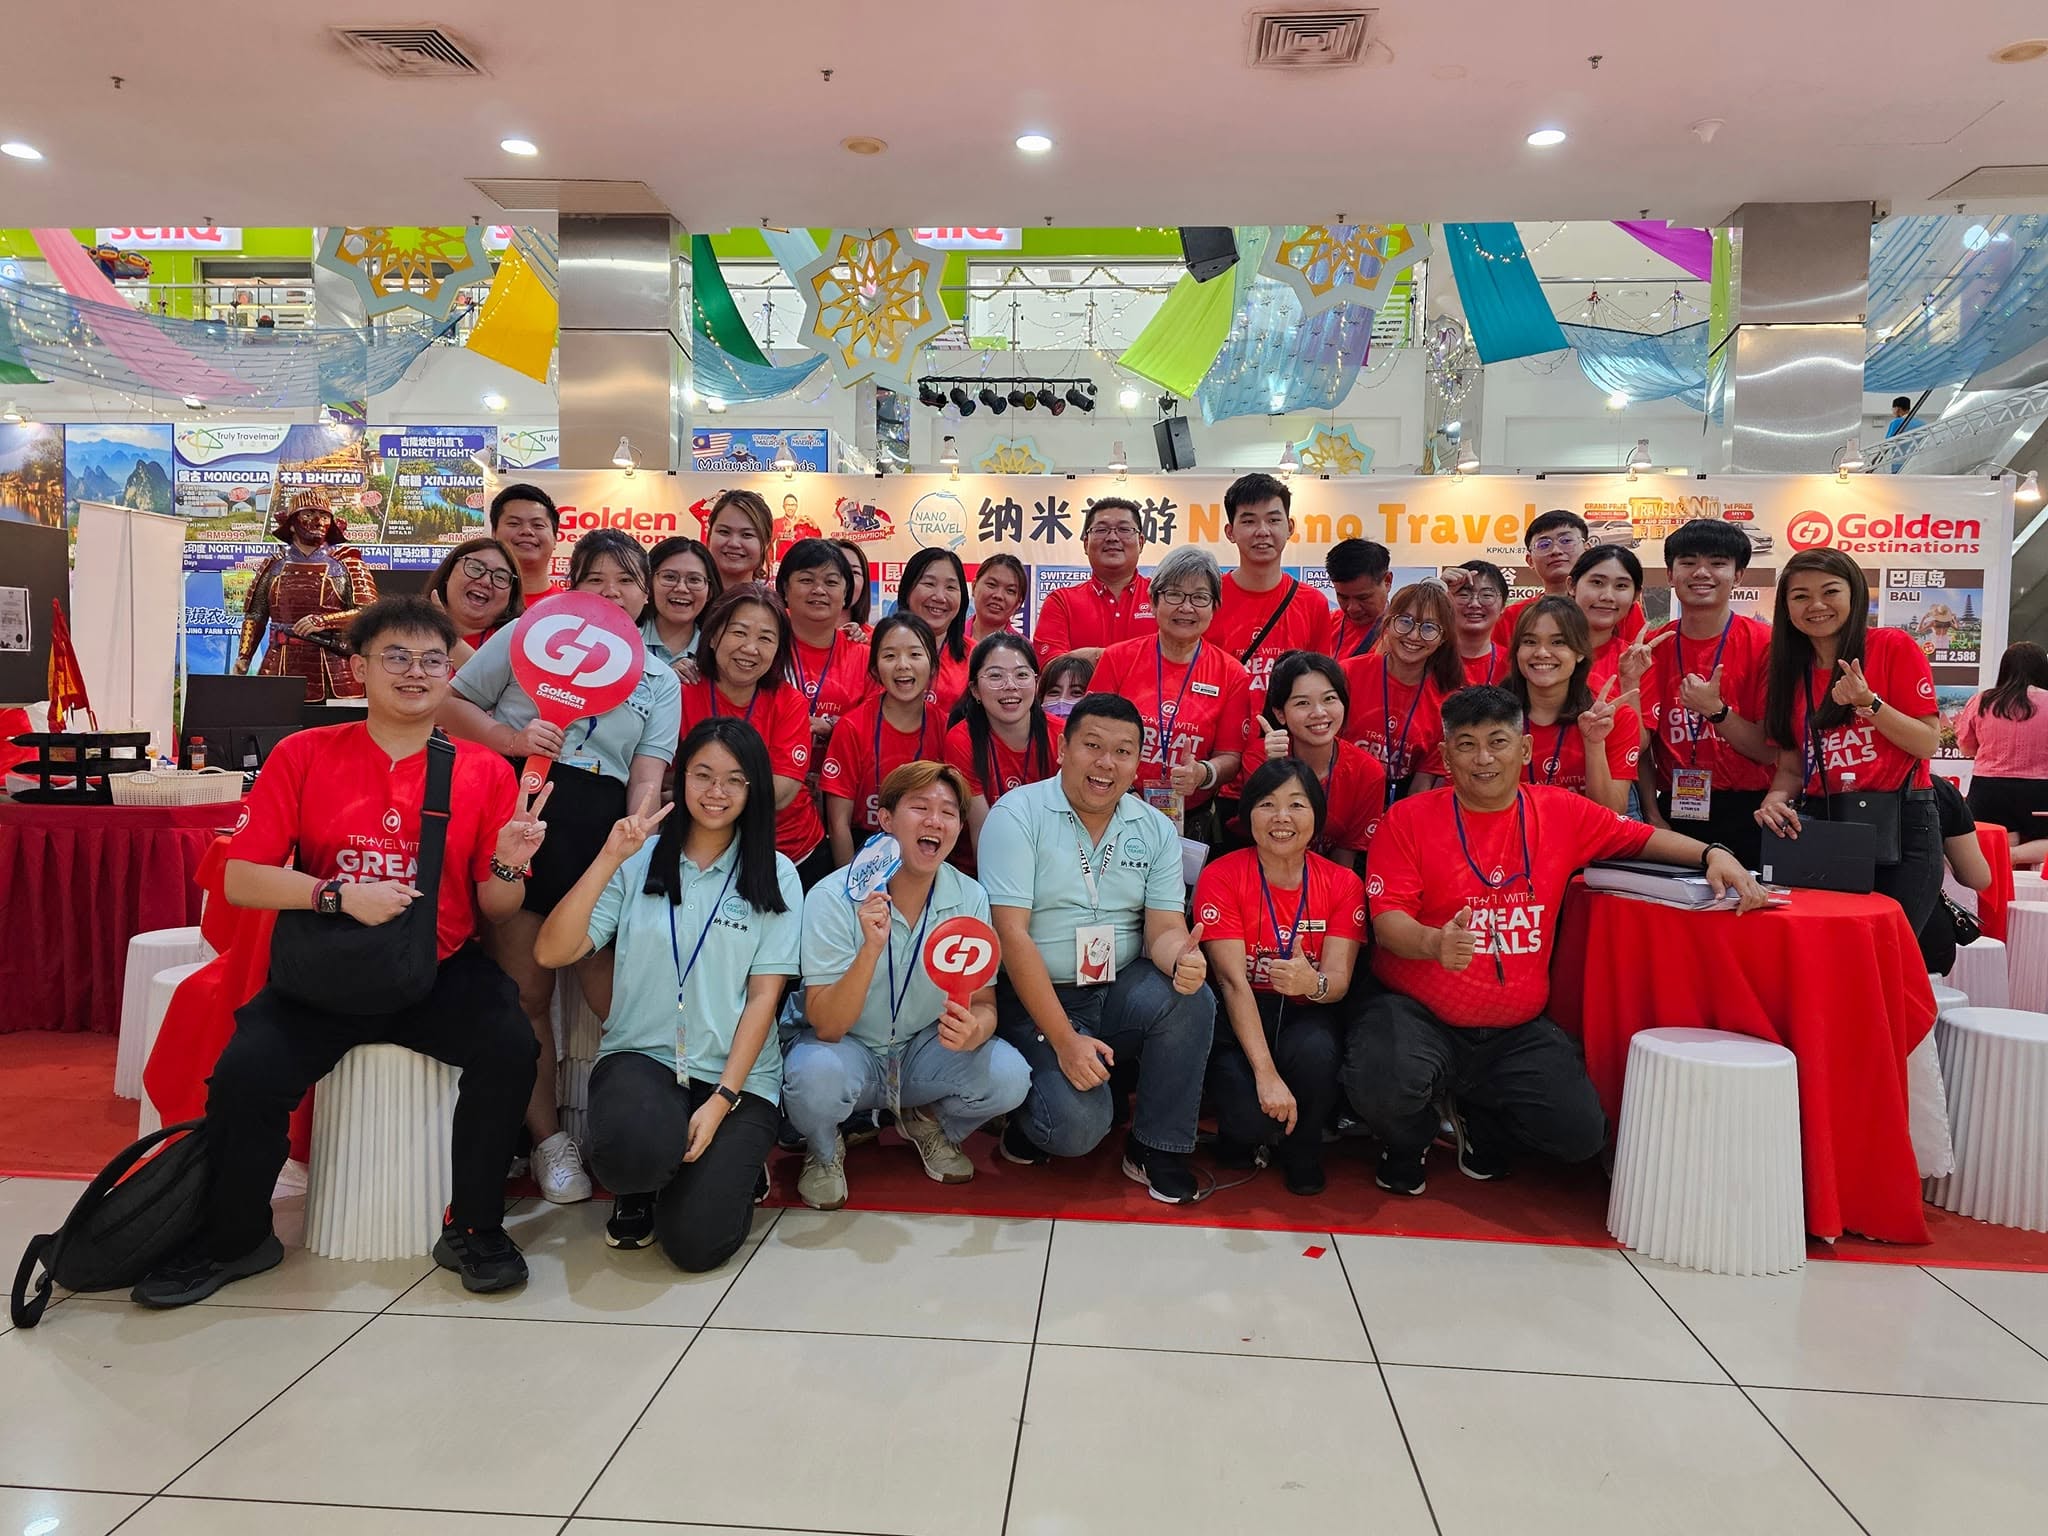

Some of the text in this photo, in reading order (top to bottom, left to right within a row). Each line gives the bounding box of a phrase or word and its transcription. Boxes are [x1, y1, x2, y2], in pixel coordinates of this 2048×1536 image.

[217, 432, 280, 441] Truly Travelmart
[400, 437, 464, 447] 吉隆坡包机直飞
[540, 434, 558, 444] Truly
[387, 448, 475, 457] KL DIRECT FLIGHTS
[697, 458, 762, 473] Malaysia
[204, 471, 269, 482] MONGOLIA
[281, 472, 361, 484] 不丹 BHUTAN
[424, 475, 484, 486] XINJIANG
[556, 506, 677, 531] Golden
[915, 511, 947, 521] NANO
[919, 523, 963, 533] TRAVEL
[1377, 503, 1537, 545] Travel
[1837, 514, 1981, 539] Golden
[208, 545, 241, 554] NORTH
[1837, 540, 1980, 554] Destinations
[1889, 570, 1946, 588] 巴厘岛
[1509, 589, 1545, 598] GKOK
[1890, 591, 1921, 602] BALI
[523, 614, 633, 688] GD
[1949, 651, 1976, 662] 2,588
[536, 690, 584, 710] Destinations
[538, 682, 586, 706] Golden
[815, 702, 841, 712] WITH
[1174, 721, 1199, 732] WITH
[1143, 726, 1204, 753] REAT
[400, 839, 420, 853] WIT
[336, 849, 418, 878] GREA
[852, 855, 880, 886] NANO
[858, 854, 897, 891] TRAVEL
[1469, 905, 1545, 930] REAT
[1469, 929, 1542, 955] EALS
[932, 935, 992, 976] GD
